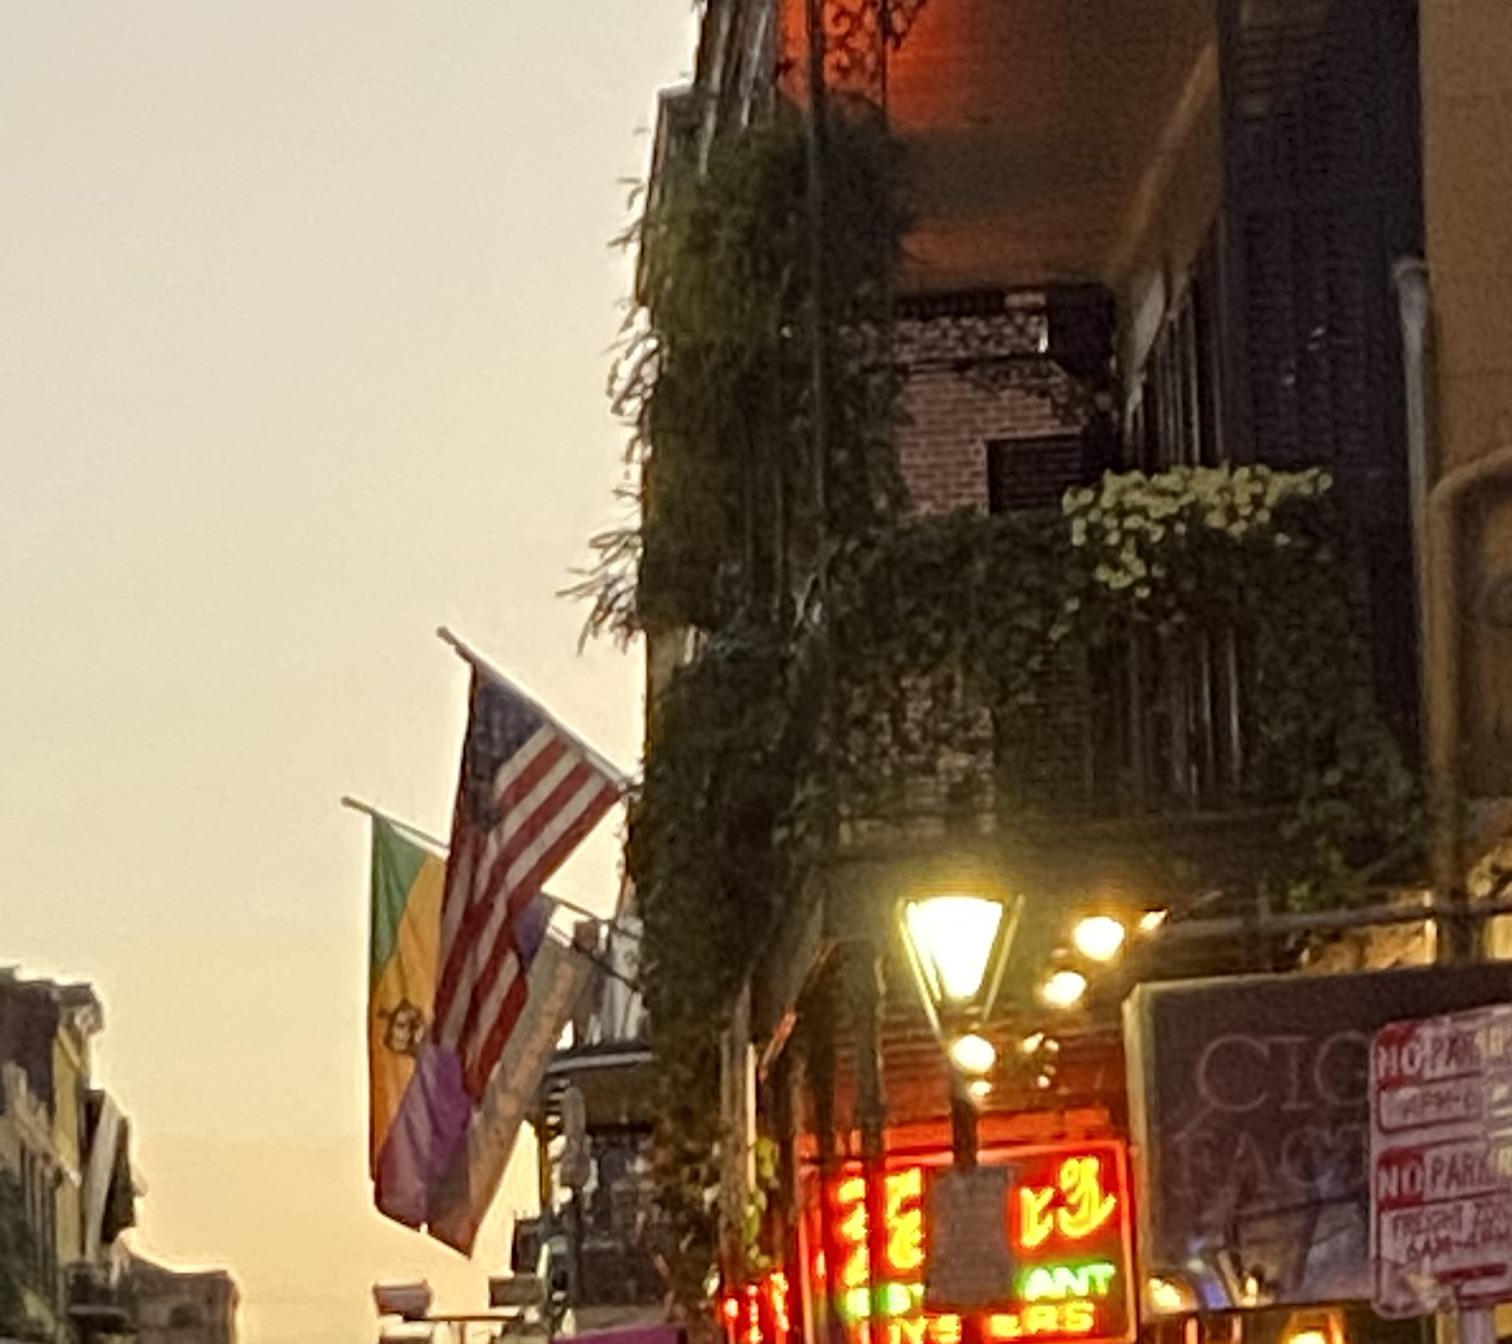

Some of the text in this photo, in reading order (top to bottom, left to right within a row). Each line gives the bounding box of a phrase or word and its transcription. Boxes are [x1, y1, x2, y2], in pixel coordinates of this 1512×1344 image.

[1199, 1030, 1369, 1112] CIG
[1171, 1124, 1369, 1197] FACT
[1377, 1160, 1424, 1201] NO
